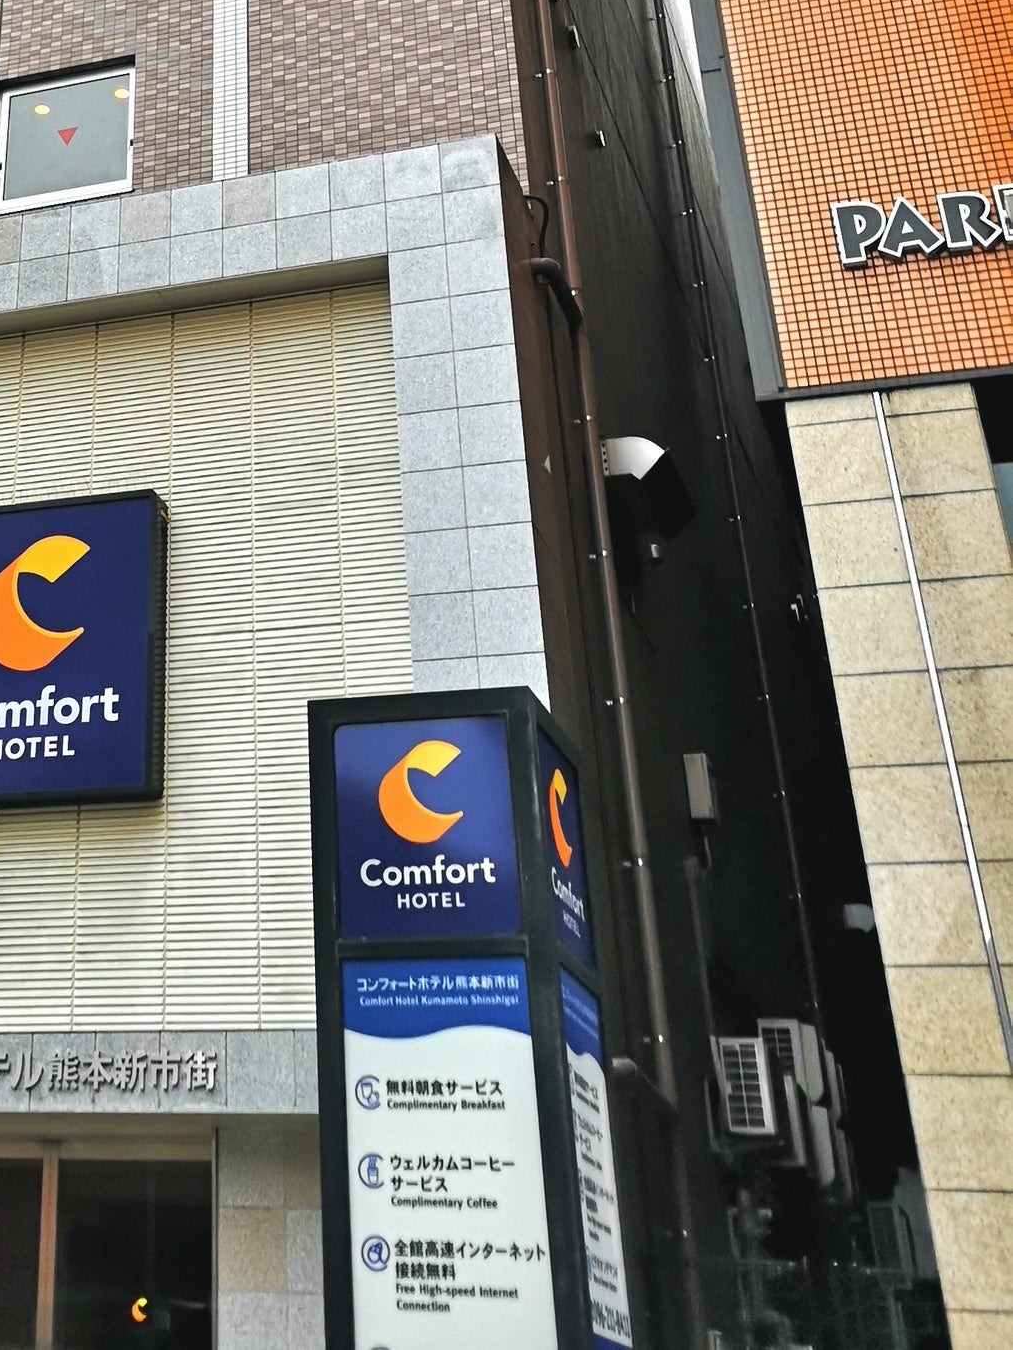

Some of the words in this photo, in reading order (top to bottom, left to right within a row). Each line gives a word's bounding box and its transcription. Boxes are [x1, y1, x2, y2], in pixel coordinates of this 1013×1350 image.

[360, 854, 496, 888] Comfort
[397, 892, 466, 909] HOTEL
[551, 866, 586, 923] Comfort
[359, 995, 394, 1007] Comfort
[395, 995, 420, 1006] Hotel
[421, 995, 469, 1006] Kumamoto
[471, 994, 519, 1007] Shinshigai
[386, 1079, 503, 1096] 無料朝食サービス
[387, 1099, 458, 1112] Complimentary
[461, 1099, 506, 1110] Breakfast
[390, 1154, 515, 1172] ウェルカムコーヒー
[391, 1175, 448, 1192] サービス
[391, 1196, 464, 1211] Complimentary
[466, 1198, 498, 1209] Coffee
[394, 1238, 546, 1262] 全館高速インターネット
[395, 1261, 456, 1281] 接続無料
[395, 1283, 416, 1295] Free
[419, 1284, 476, 1298] High-speed
[479, 1286, 519, 1298] Internet
[396, 1301, 451, 1313] Connection
